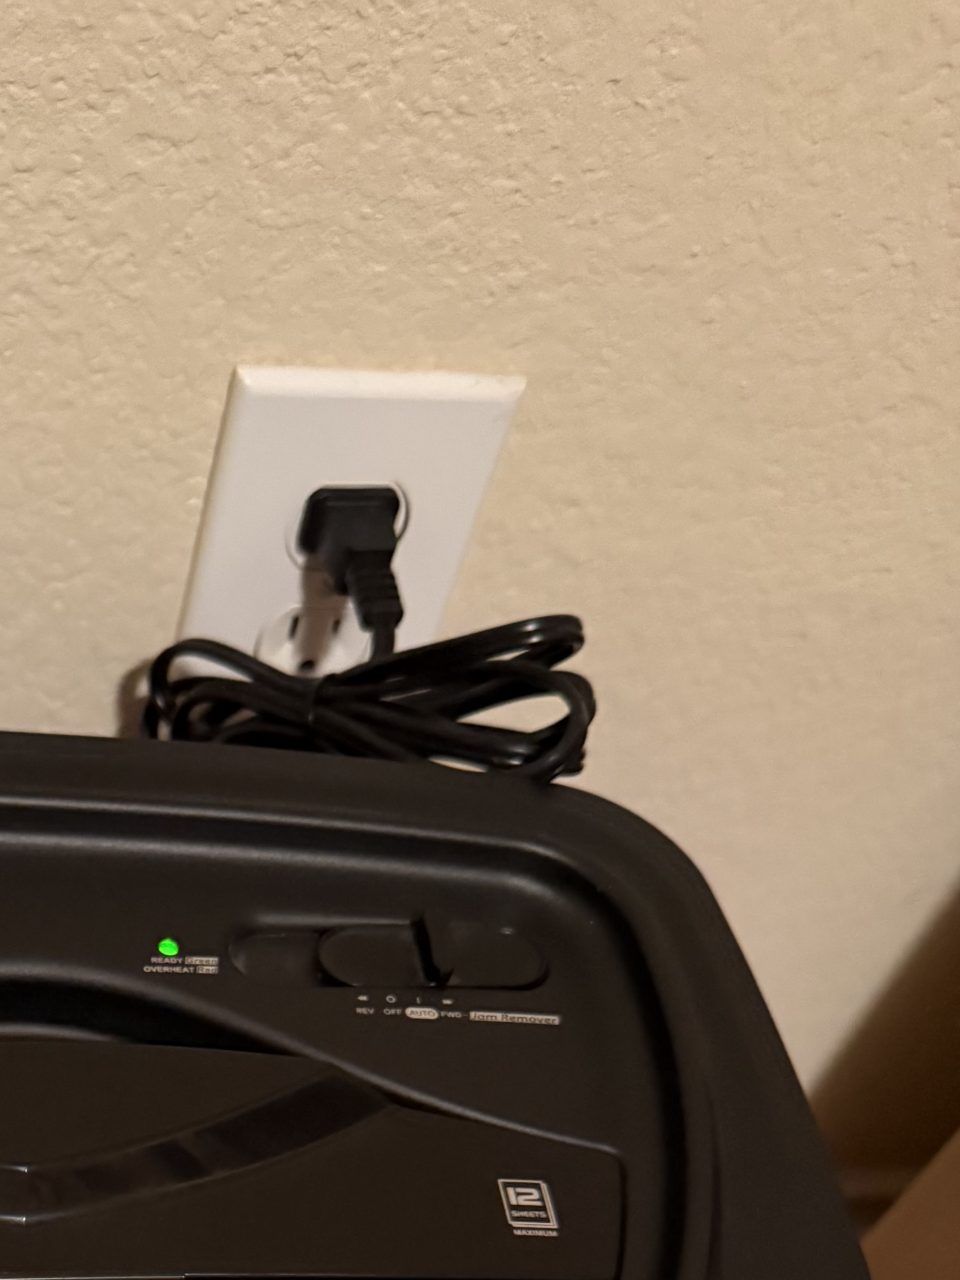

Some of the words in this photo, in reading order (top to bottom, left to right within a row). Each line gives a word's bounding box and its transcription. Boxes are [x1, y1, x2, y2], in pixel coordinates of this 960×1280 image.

[409, 1009, 436, 1017] AUTO
[501, 1013, 557, 1024] Remover
[506, 1187, 543, 1206] 12
